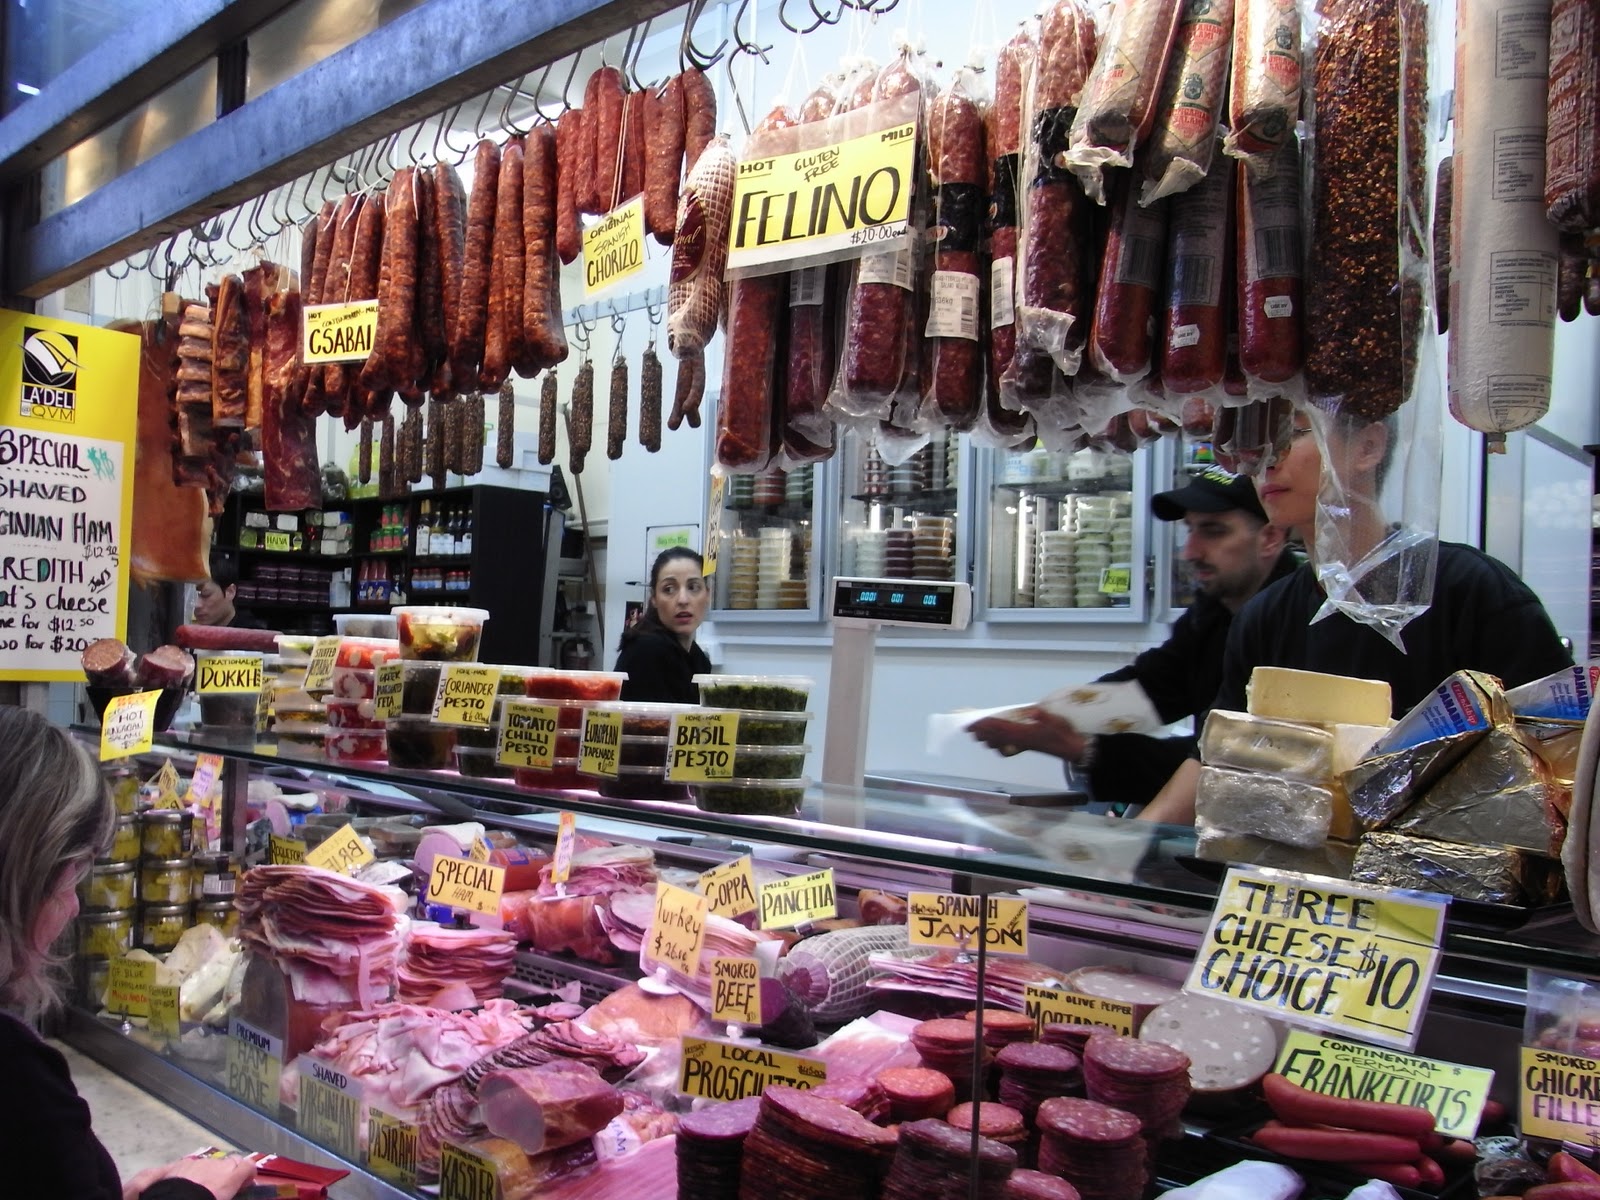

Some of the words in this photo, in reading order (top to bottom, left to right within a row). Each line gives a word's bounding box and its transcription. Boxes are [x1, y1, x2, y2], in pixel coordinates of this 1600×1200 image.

[881, 127, 914, 142] MILD
[740, 159, 776, 175] HOT
[793, 146, 840, 172] GLUTEN
[803, 157, 840, 183] FREE
[735, 166, 901, 248] FELINO
[590, 210, 635, 239] ORIGINAL
[594, 221, 631, 256] SPANISH
[587, 239, 638, 287] CHORIZO
[308, 312, 322, 320] HOT
[309, 324, 371, 354] CSABAI
[22, 385, 76, 410] LA'DELI
[32, 405, 74, 422] QVM
[0, 429, 90, 472] SPECIAL
[73, 512, 113, 545] HAM
[0, 556, 84, 584] REDITH
[46, 586, 110, 614] cheese
[21, 613, 41, 630] for
[25, 634, 45, 650] for
[379, 670, 401, 682] GREEK
[445, 678, 494, 696] CORIANDER
[377, 695, 395, 708] FETA
[444, 697, 485, 709] PESTO
[508, 713, 555, 732] TOMATO
[585, 719, 619, 746] EUROPEAN
[676, 725, 730, 746] BASIL
[505, 729, 548, 744] CHILLI
[505, 741, 548, 756] PESTO
[584, 745, 614, 761] TAPENADE
[673, 749, 729, 768] PESTO
[430, 859, 497, 897] SPECIAL
[729, 861, 740, 869] HOT
[807, 872, 826, 882] HOT
[452, 886, 474, 903] HAM
[705, 873, 755, 912] COPPA
[764, 880, 790, 891] MILD
[761, 883, 835, 922] PANCETTA
[936, 895, 998, 919] SPANIH
[1238, 880, 1375, 932] THREE
[657, 888, 701, 951] Turkey
[1213, 913, 1355, 969] CHEESE
[715, 960, 757, 979] SMOKED
[1201, 948, 1350, 1016] CHOICE
[715, 979, 756, 1015] BEEF
[1026, 987, 1058, 1000] PLAIN
[1066, 996, 1096, 1009] OLIVE
[1101, 1001, 1132, 1015] PEPPER
[236, 1023, 271, 1051] PREMIUM
[721, 1045, 780, 1068] LOCAL
[1320, 1039, 1442, 1072] CONTINENTAL
[1335, 1053, 1432, 1079] GERMAN
[1535, 1052, 1597, 1071] SMOKED
[230, 1063, 269, 1108] BONE
[312, 1063, 347, 1089] SHAVED
[300, 1075, 357, 1155] VIRGINIAN
[368, 1118, 417, 1174] PASTRAMI
[440, 1152, 494, 1200] KASSLER
